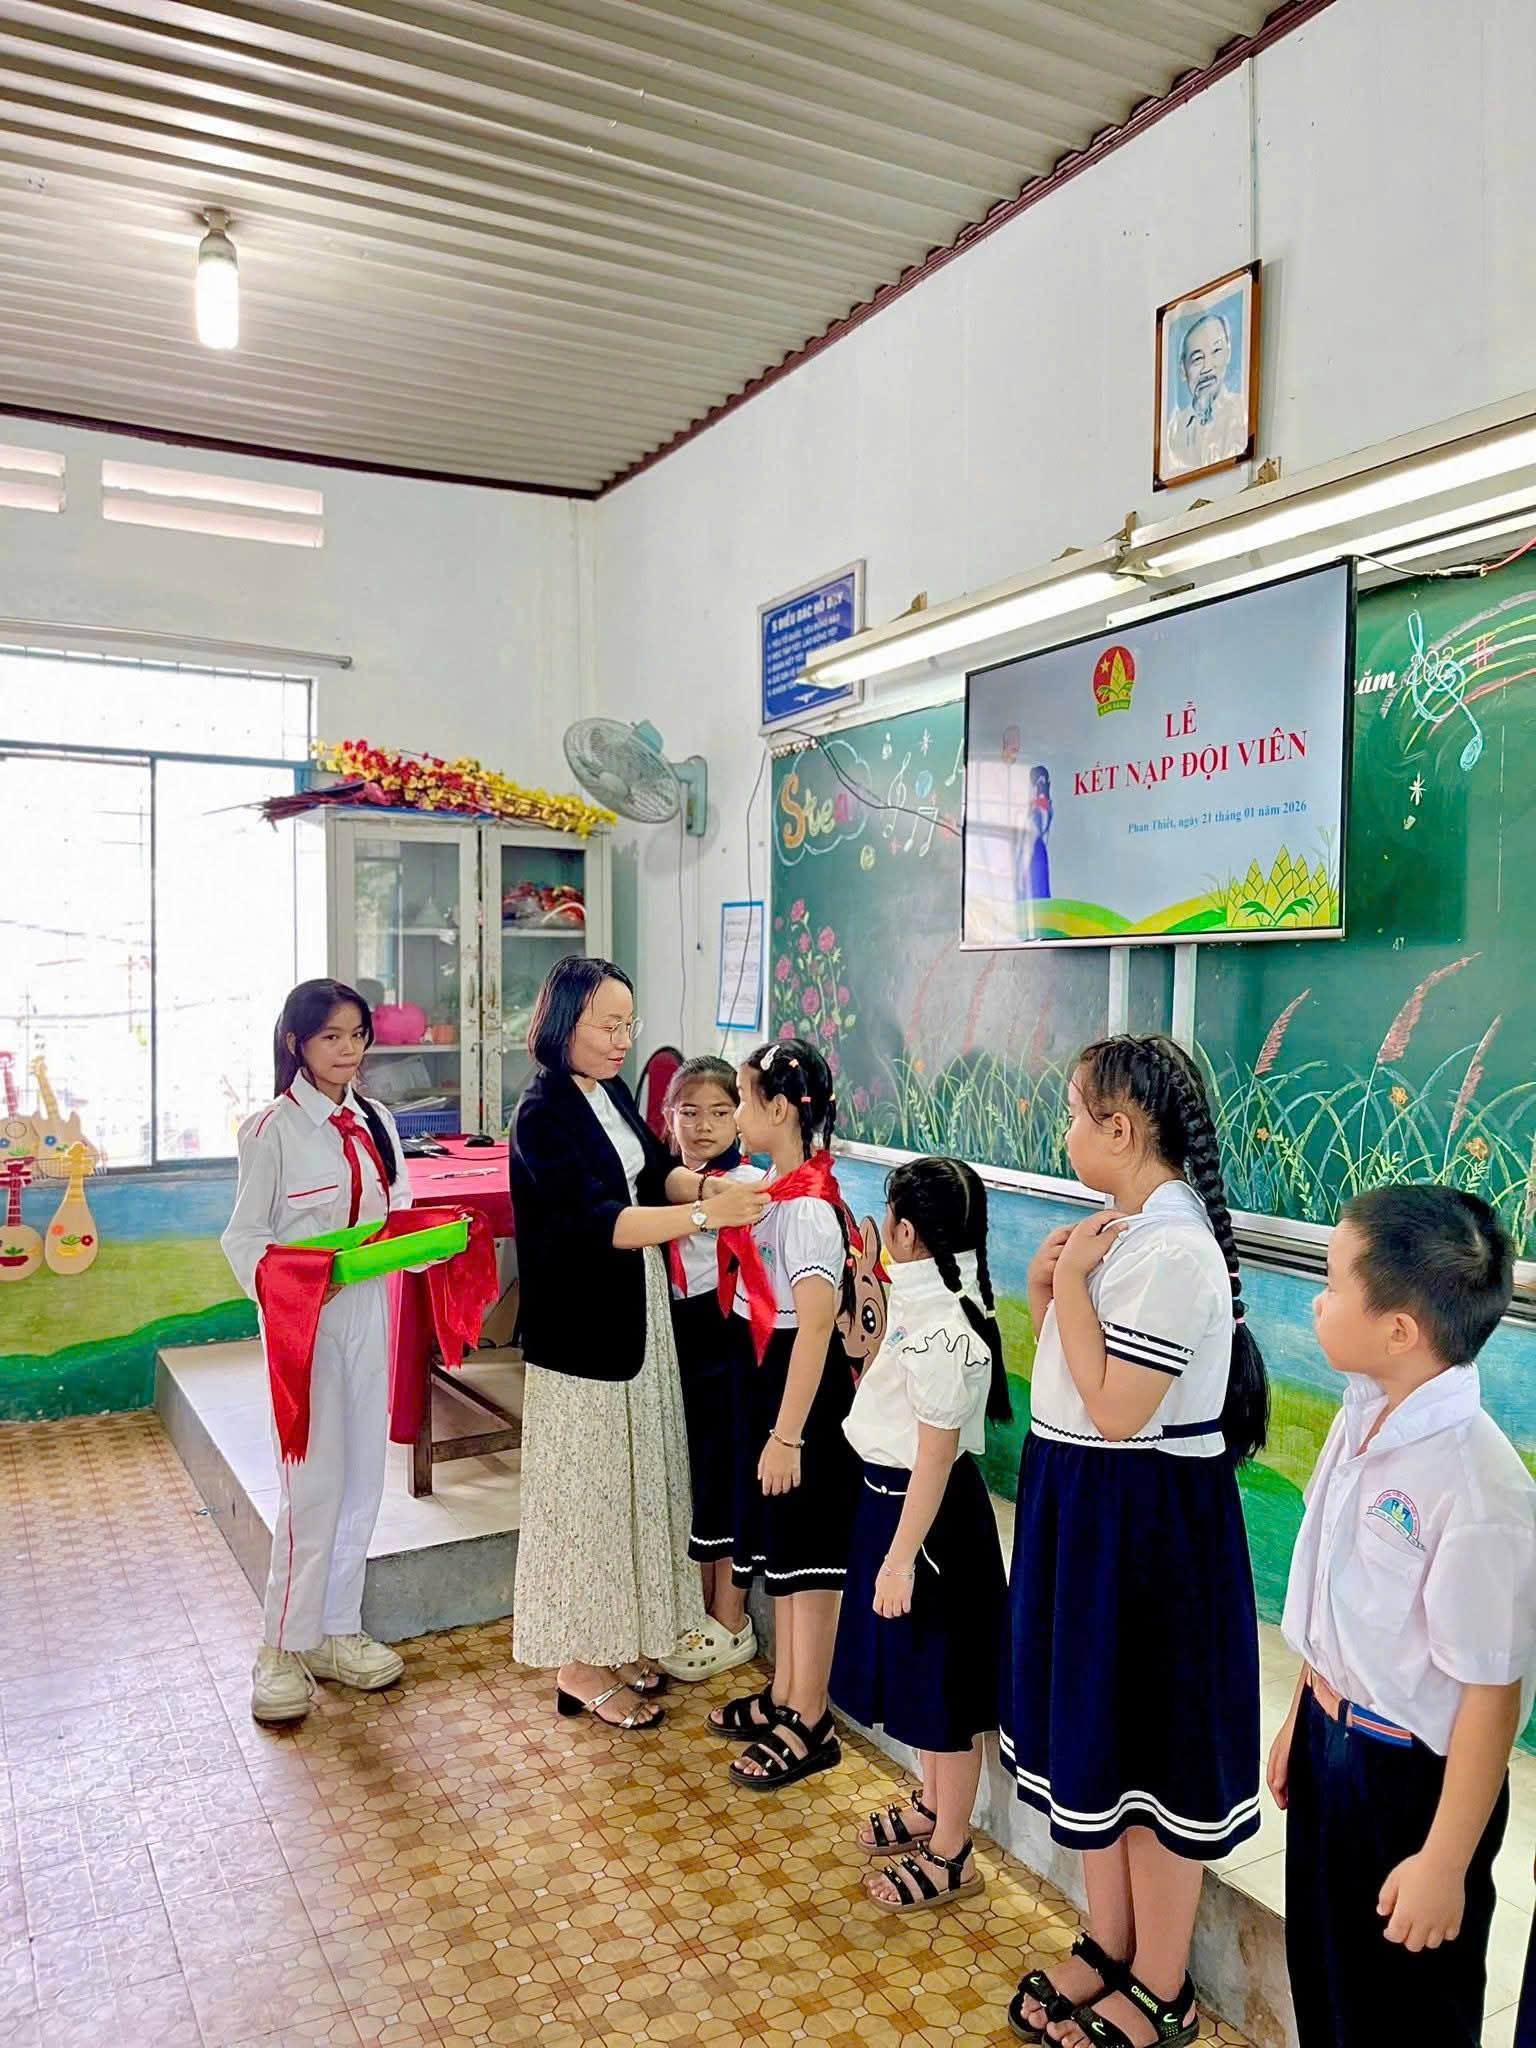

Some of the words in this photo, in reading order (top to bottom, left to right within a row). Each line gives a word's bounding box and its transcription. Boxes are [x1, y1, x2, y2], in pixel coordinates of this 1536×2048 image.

[1354, 668, 1397, 696] ăm
[1164, 701, 1198, 738] LỄ
[1073, 761, 1119, 796] KẾT
[1126, 755, 1174, 790] NẠP
[1182, 744, 1230, 781] ĐỘI
[1237, 727, 1308, 767] VIÊN
[1201, 811, 1212, 824] 21
[1215, 809, 1242, 823] tháng
[1244, 807, 1255, 817] 01
[1258, 805, 1280, 817] năm
[1282, 800, 1307, 814] 2026
